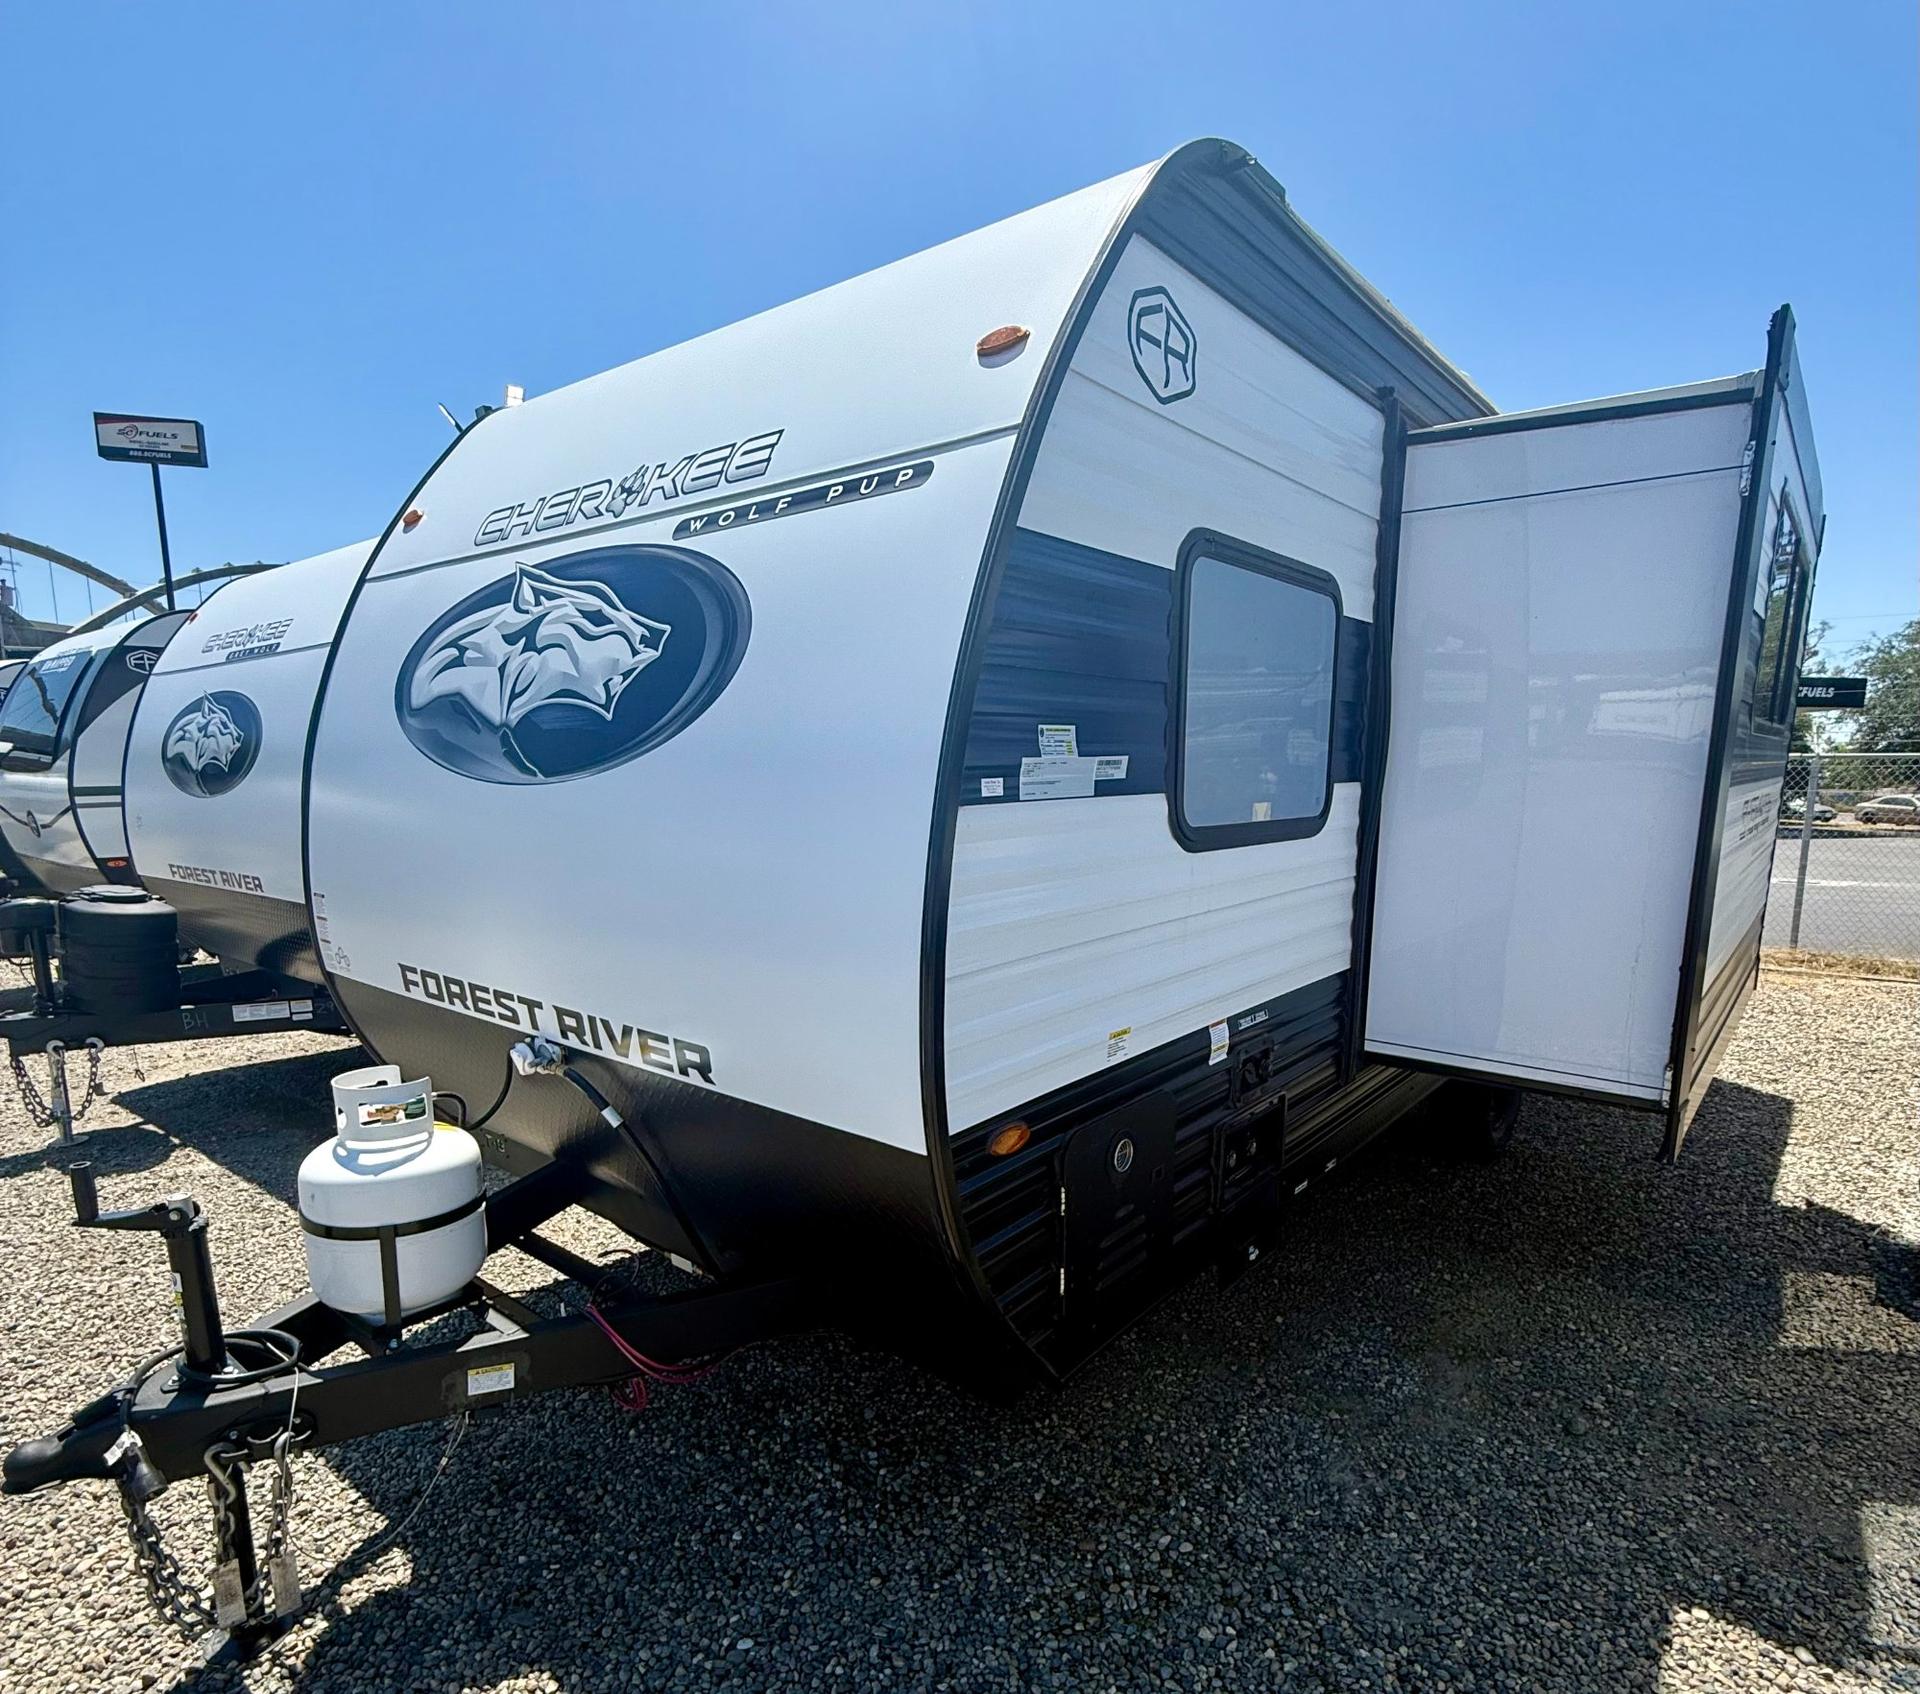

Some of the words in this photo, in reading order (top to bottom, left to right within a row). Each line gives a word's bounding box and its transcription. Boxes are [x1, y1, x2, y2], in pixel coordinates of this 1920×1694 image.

[139, 430, 179, 440] FUELS
[689, 497, 792, 533] WOLF
[826, 468, 914, 503] PUP
[168, 863, 218, 886] FOREST
[219, 870, 264, 893] RIVER
[397, 962, 543, 1031] FOREST
[552, 1004, 716, 1086] RIVER
